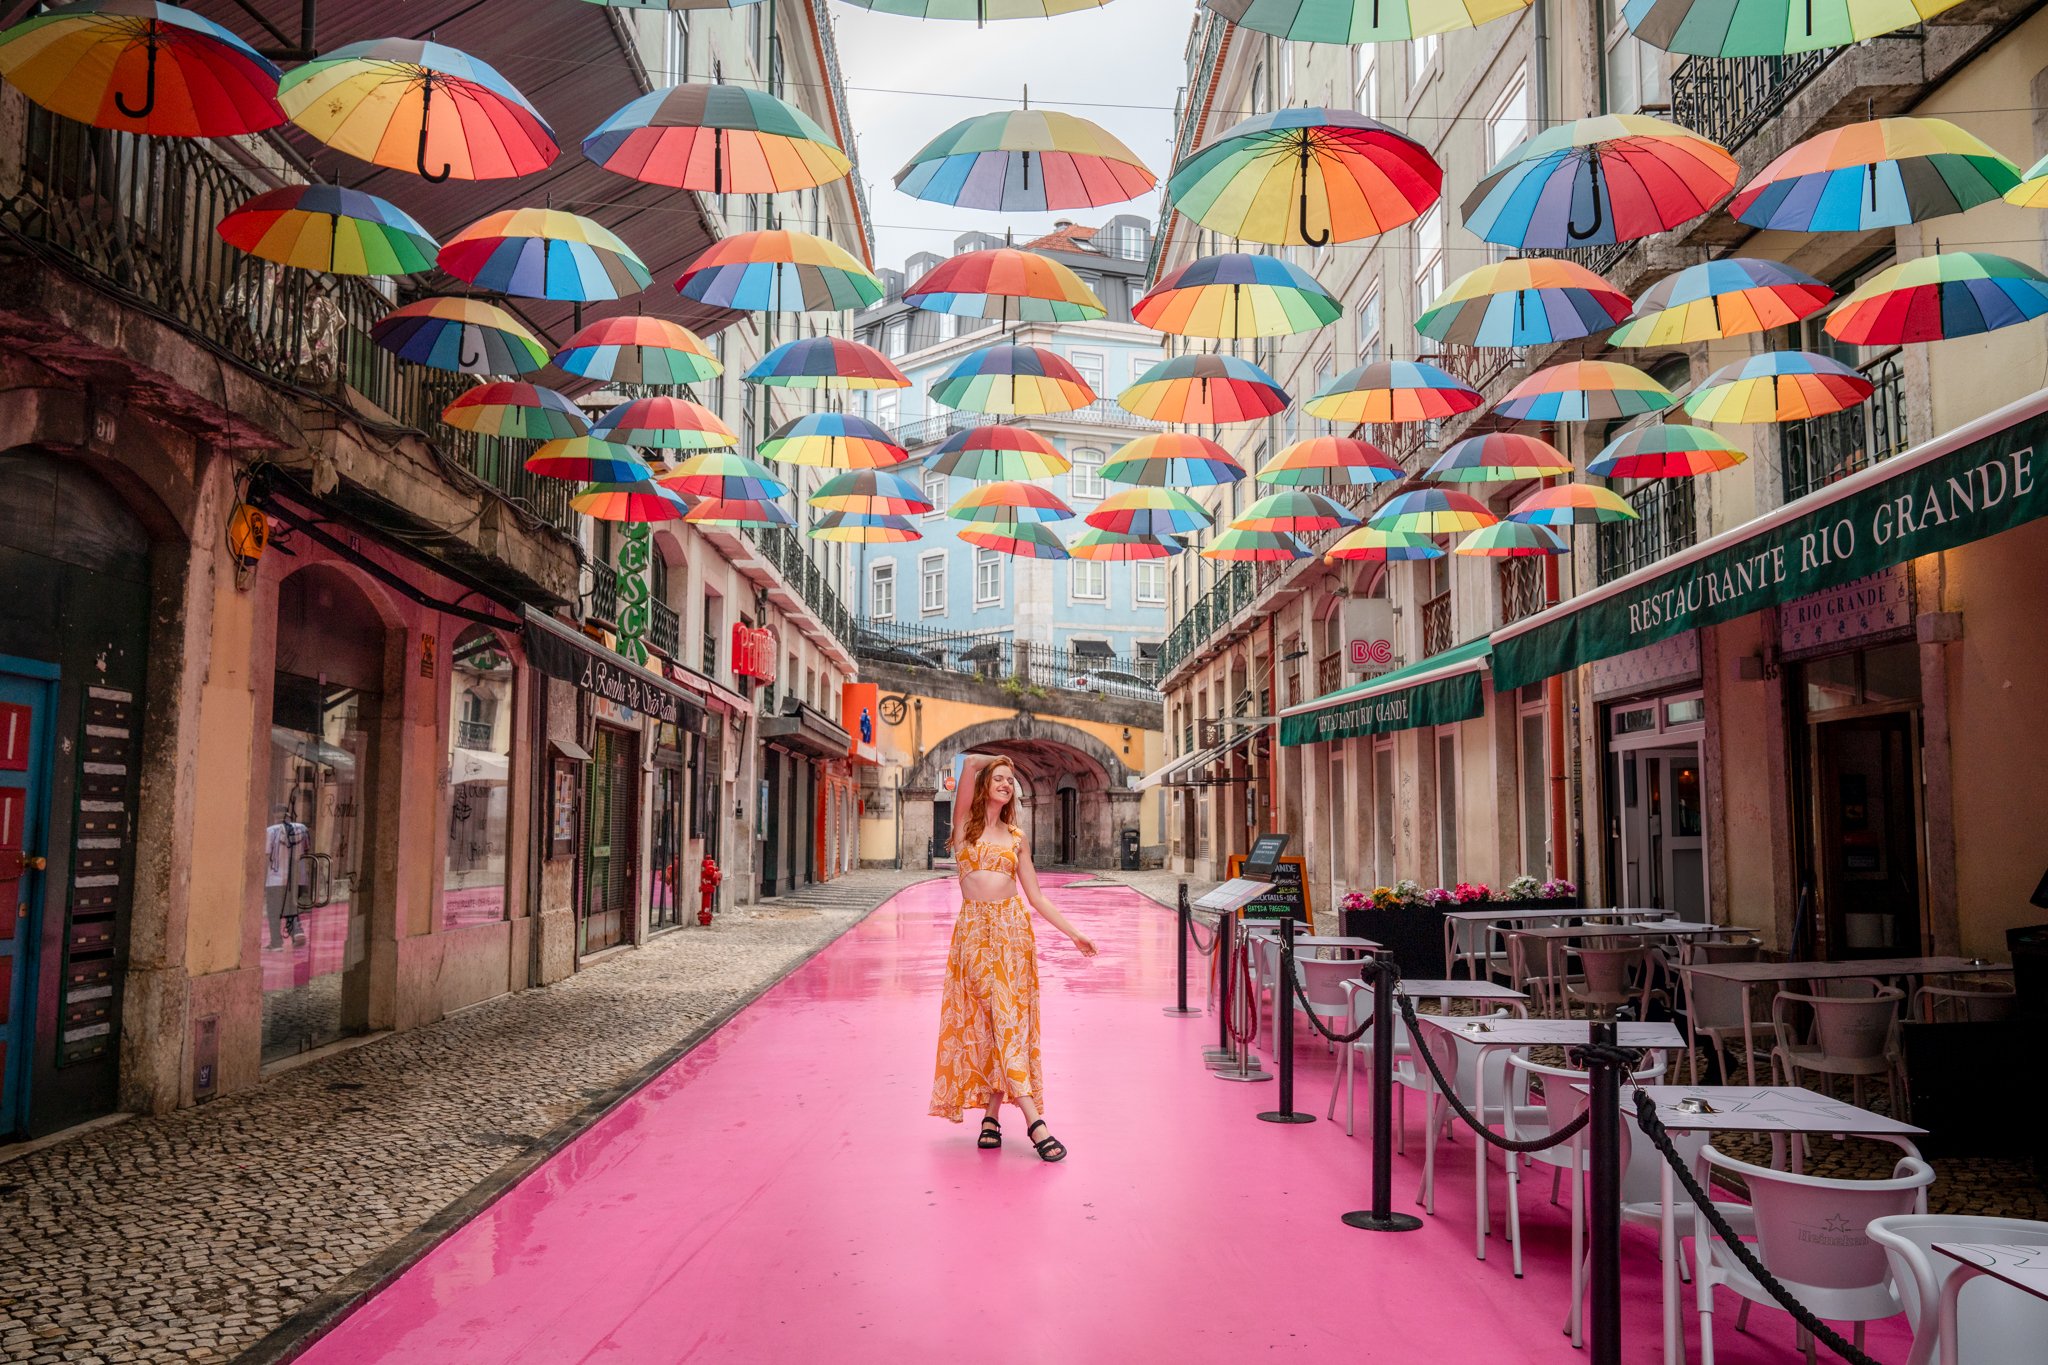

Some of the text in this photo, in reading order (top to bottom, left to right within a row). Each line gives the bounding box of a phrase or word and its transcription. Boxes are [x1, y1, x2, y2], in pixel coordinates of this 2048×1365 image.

[1628, 547, 1787, 635] RESTAURANTE
[1800, 518, 1856, 574] RIO
[1872, 446, 2035, 546] GRANDE
[1798, 602, 1821, 624] RIO
[1827, 584, 1887, 616] GRANDE
[1351, 639, 1392, 664] BC
[1360, 705, 1373, 725] RIO
[1275, 864, 1296, 872] ANDE
